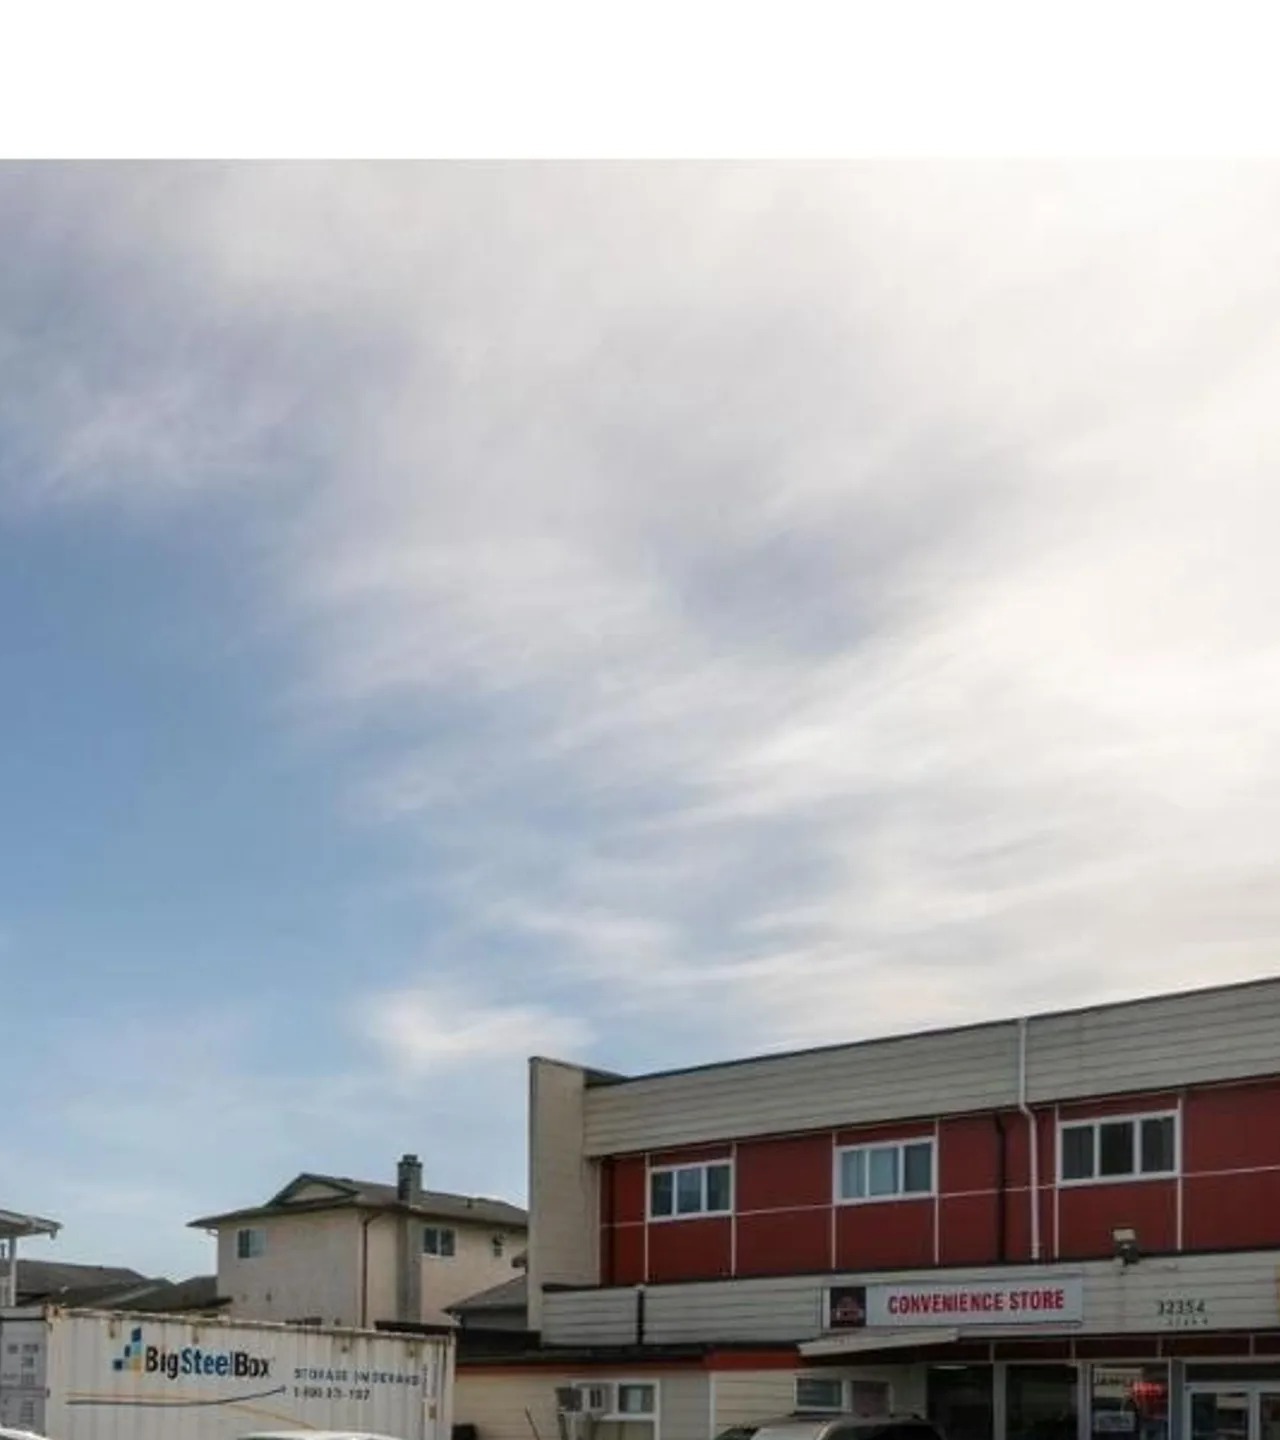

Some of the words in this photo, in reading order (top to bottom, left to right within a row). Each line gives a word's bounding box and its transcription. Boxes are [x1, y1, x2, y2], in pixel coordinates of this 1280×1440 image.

[888, 1292, 1004, 1315] CONVENIENCE
[1009, 1289, 1065, 1310] STORE
[144, 1345, 271, 1379] BigSteelBox
